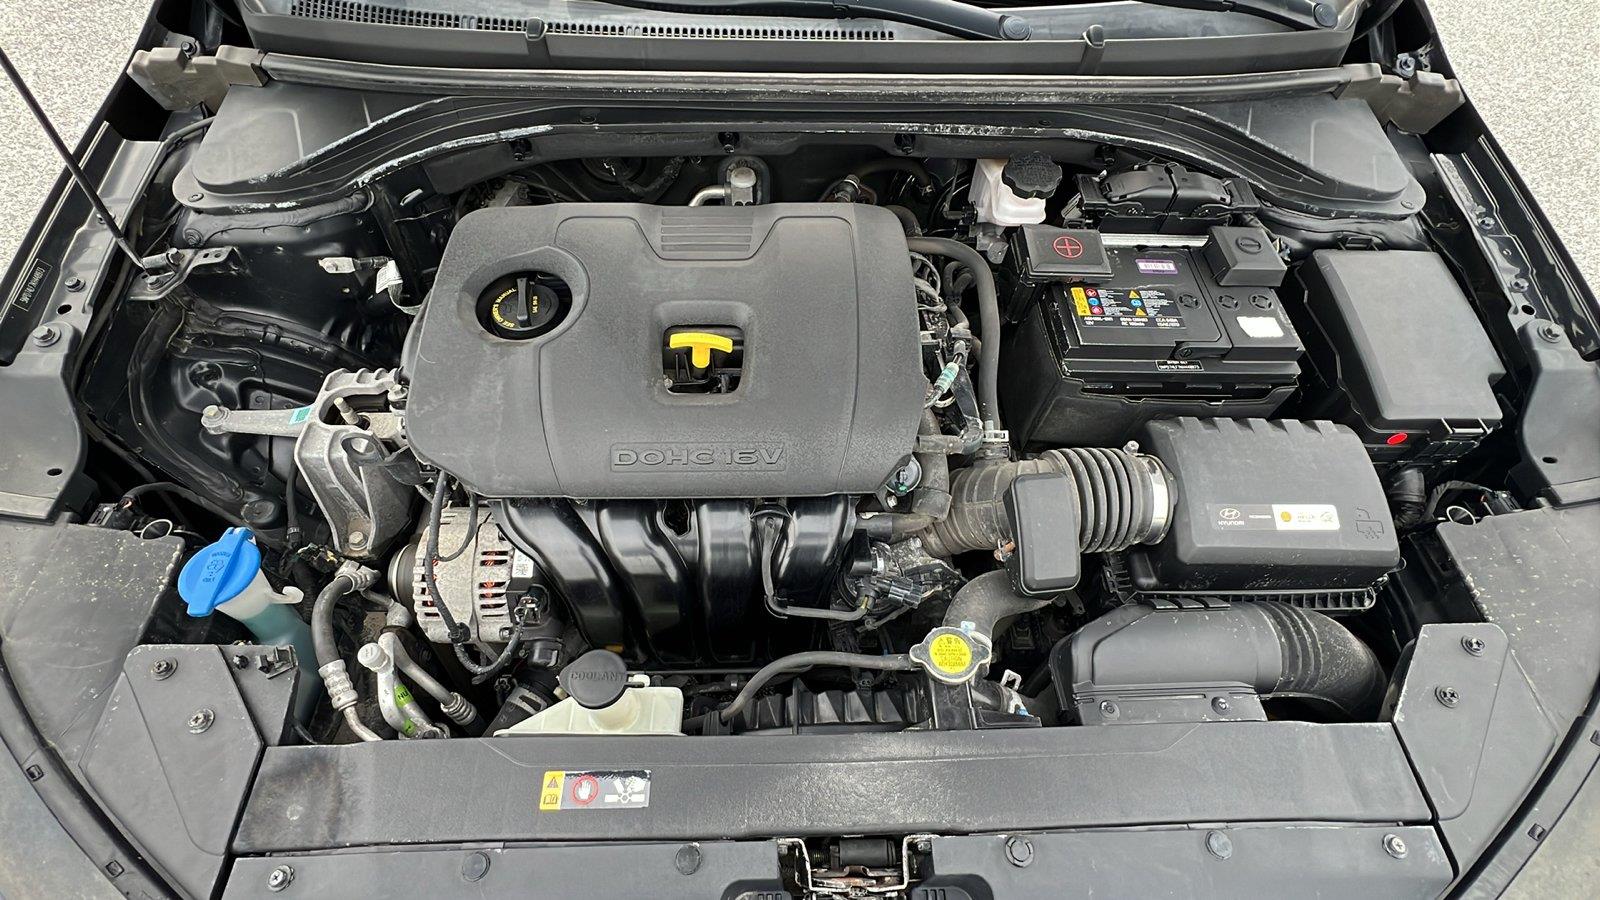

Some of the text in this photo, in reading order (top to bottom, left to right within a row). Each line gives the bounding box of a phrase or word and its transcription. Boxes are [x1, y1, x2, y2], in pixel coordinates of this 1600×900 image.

[614, 449, 784, 466] DOHC 16V
[570, 670, 626, 682] COOLANT
